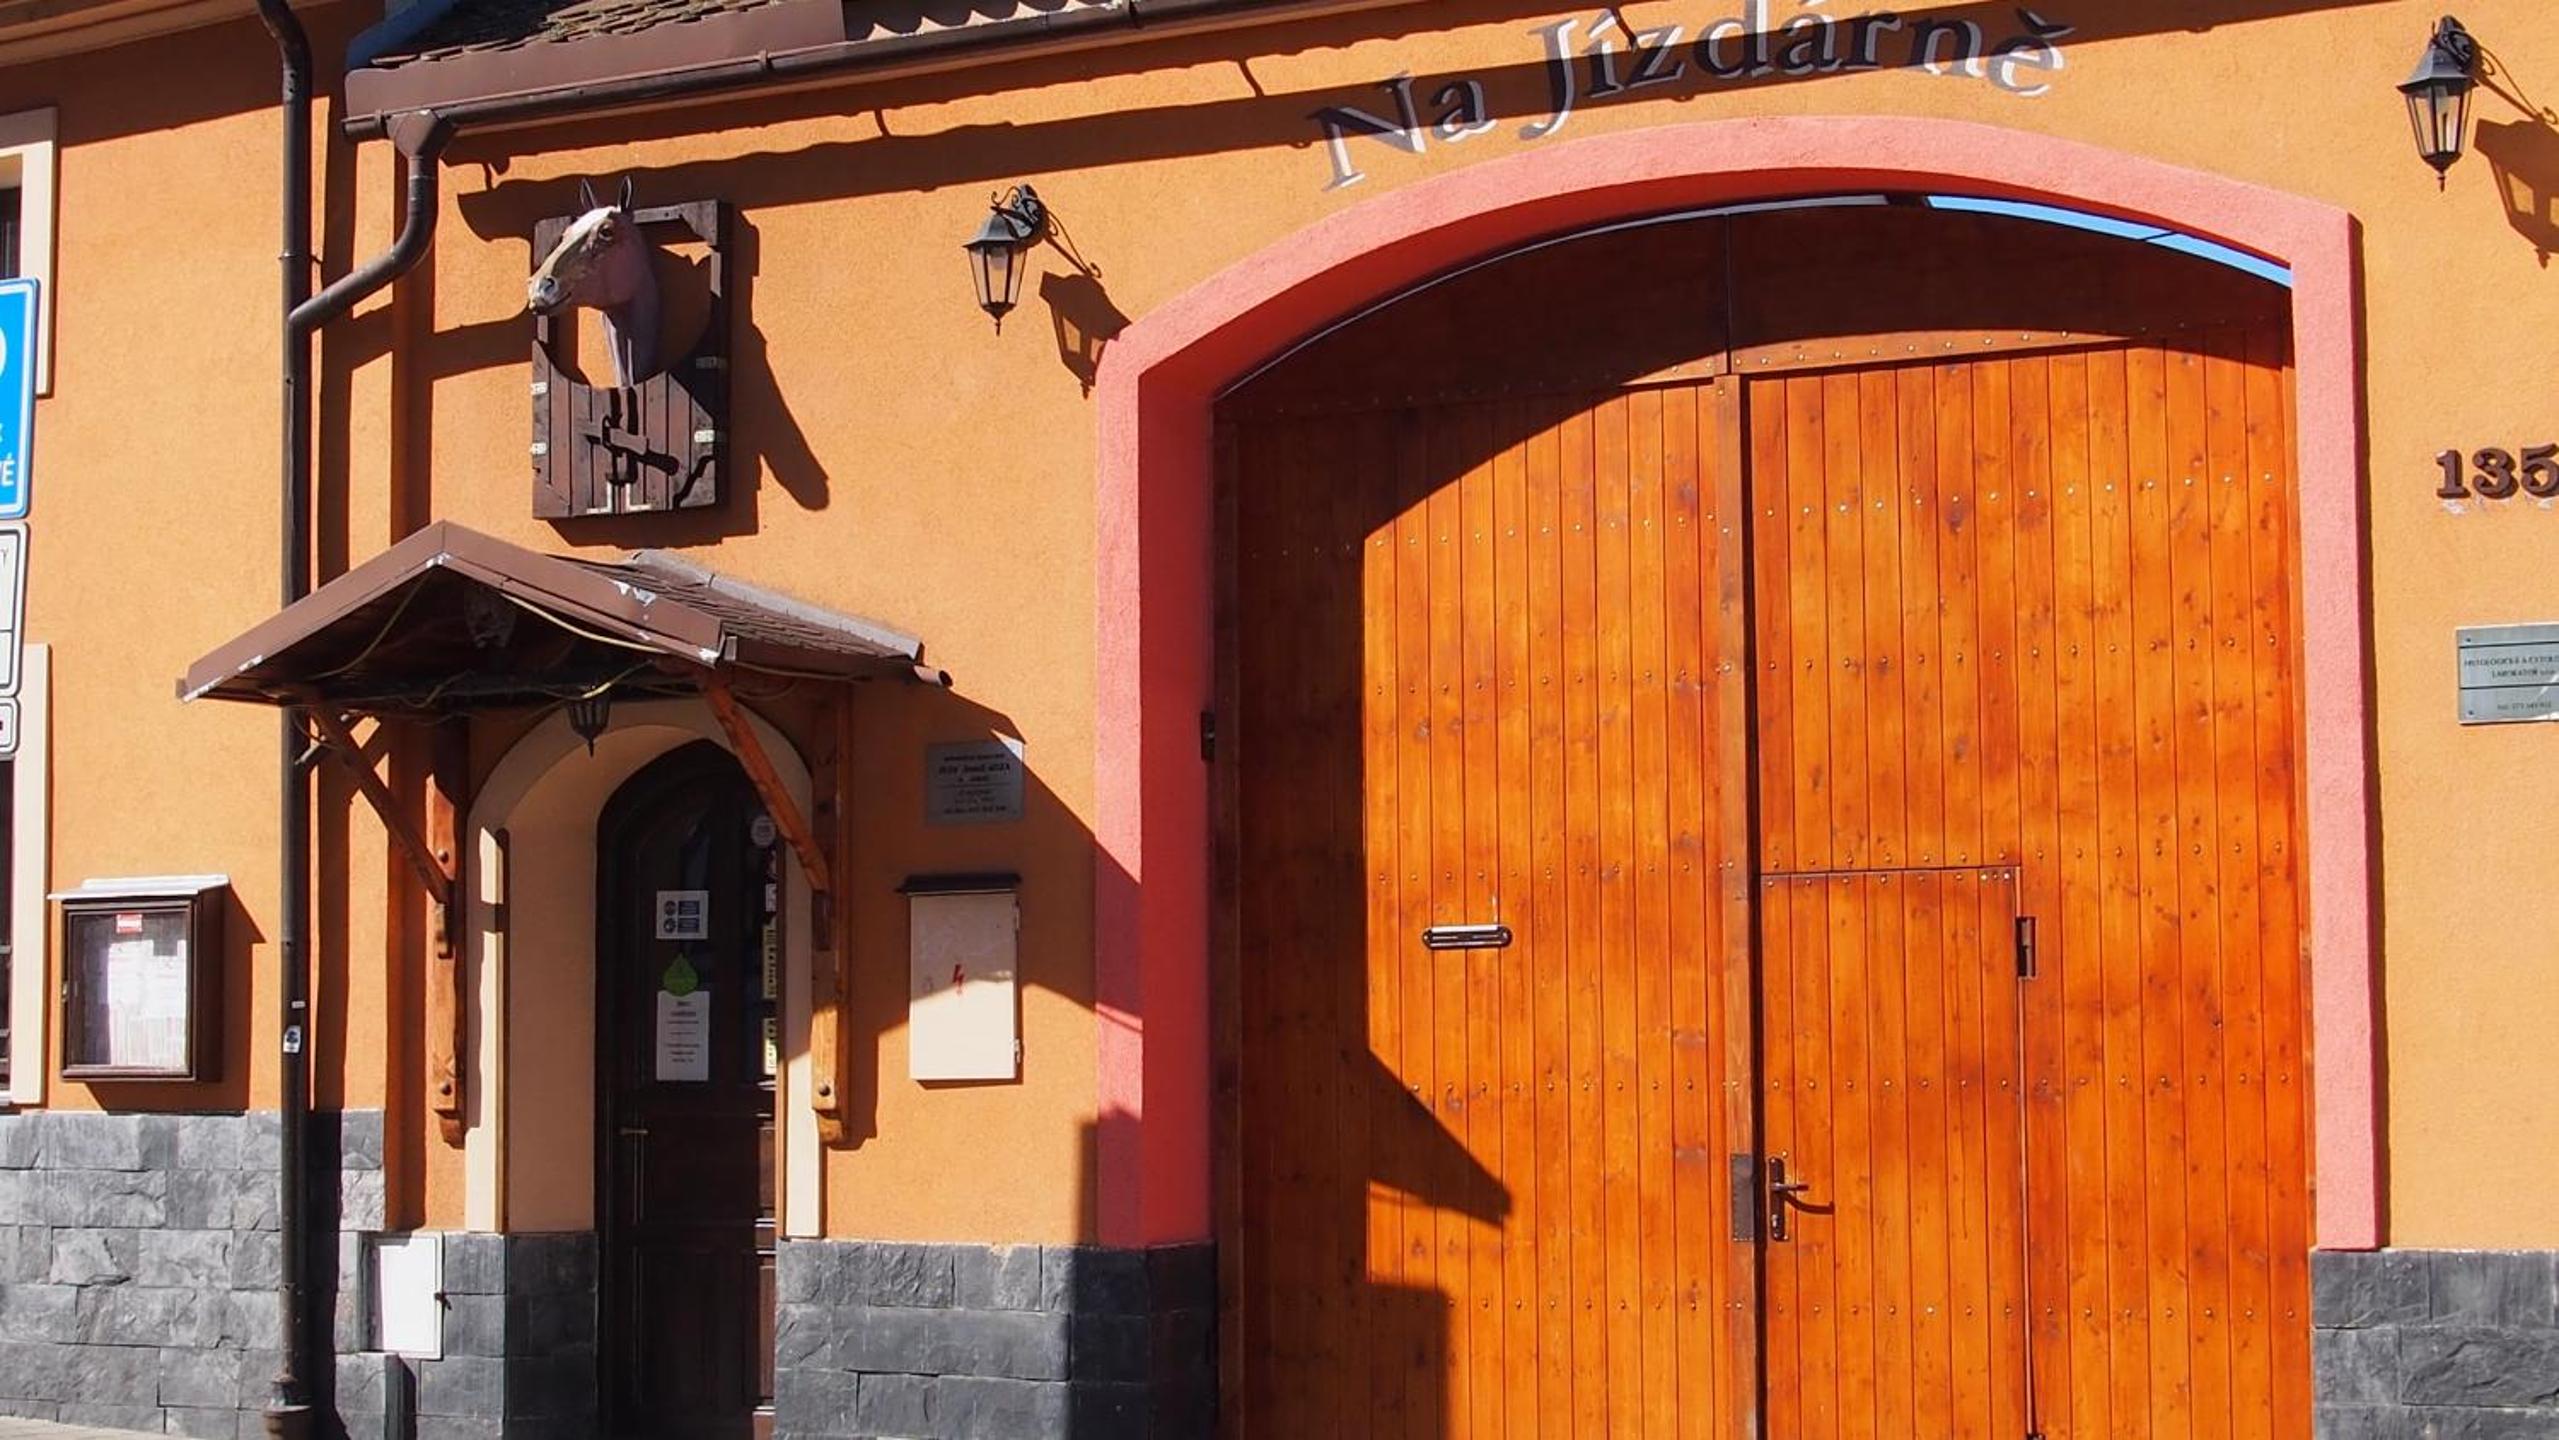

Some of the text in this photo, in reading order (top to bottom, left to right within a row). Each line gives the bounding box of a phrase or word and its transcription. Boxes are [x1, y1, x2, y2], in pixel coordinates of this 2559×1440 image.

[1307, 0, 2076, 191] Na Jízdárně
[2436, 443, 2559, 499] 135
